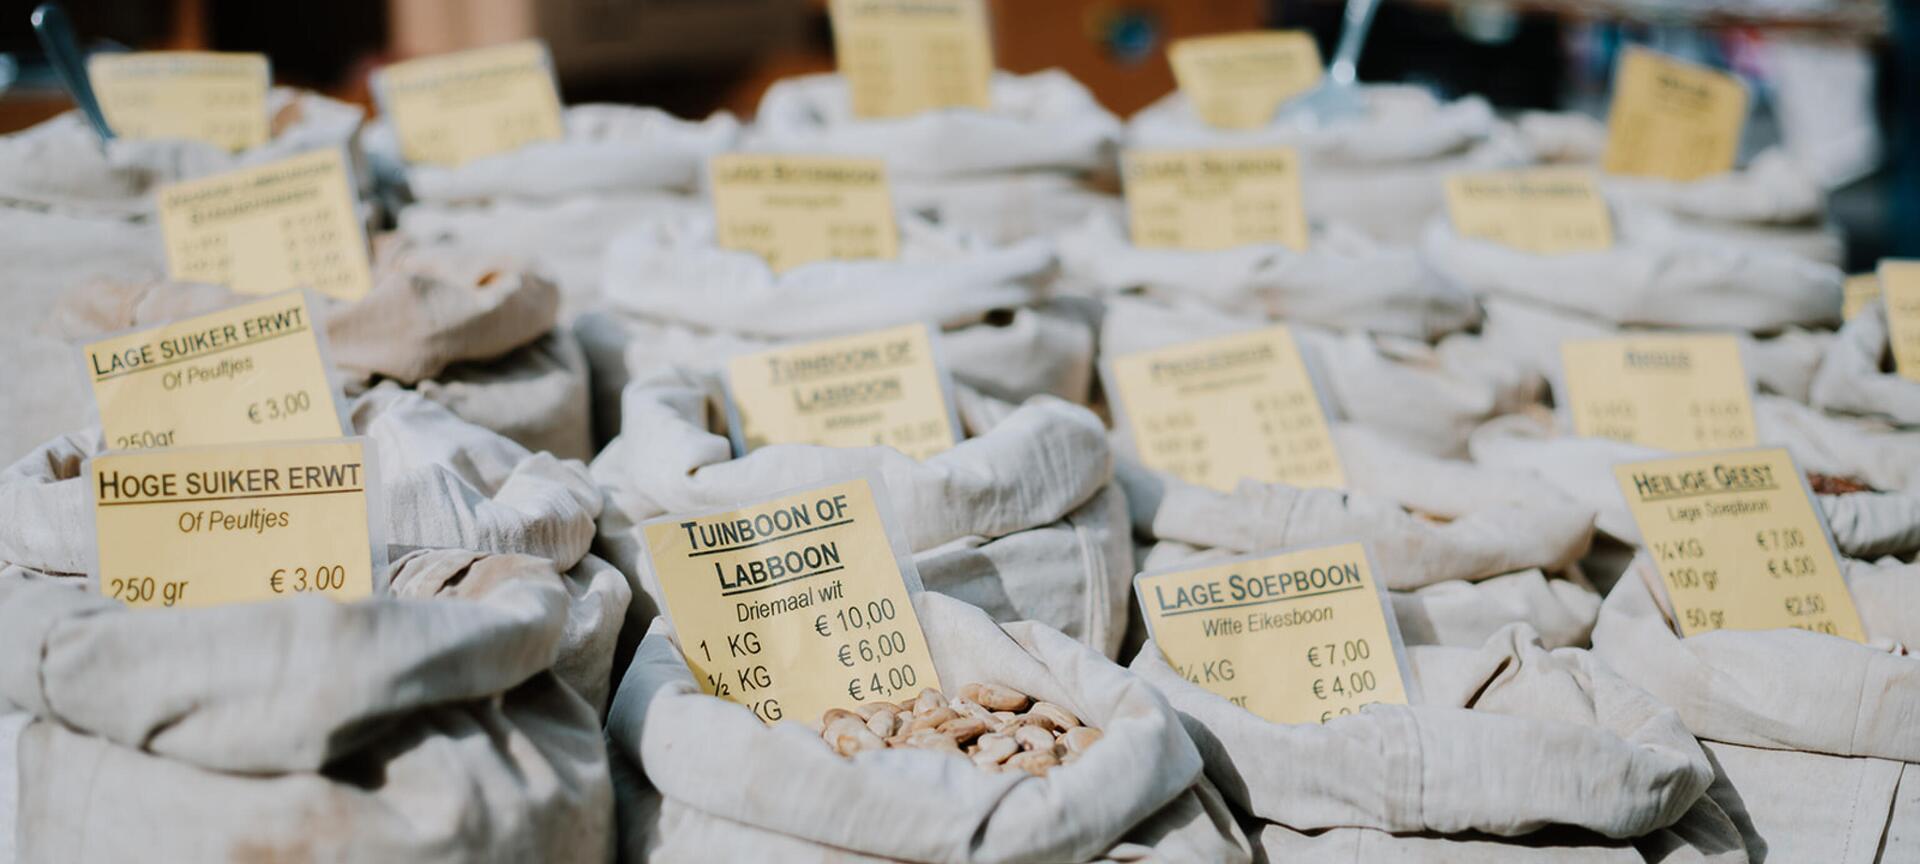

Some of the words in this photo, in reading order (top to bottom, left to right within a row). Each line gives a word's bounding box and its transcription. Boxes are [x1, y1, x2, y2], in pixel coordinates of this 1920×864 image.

[91, 344, 155, 375] LAGE
[160, 324, 238, 359] SUIKER
[244, 306, 303, 339] ERWT
[162, 367, 183, 391] Of
[188, 355, 254, 385] Peultjes
[99, 471, 177, 500] HOGE
[185, 468, 280, 496] SUIKER
[288, 463, 361, 490] ERWT
[1632, 466, 1708, 496] HEILIGE
[1713, 463, 1773, 488] GEEST
[178, 511, 204, 533] Of
[208, 508, 289, 534] Peultjes
[680, 503, 812, 551] TUINBOON
[815, 494, 849, 521] OF
[715, 541, 841, 590] LABBOON
[111, 577, 155, 602] 250
[162, 579, 189, 607] gr
[736, 586, 815, 623] Driemaal
[819, 579, 845, 604] wit
[1155, 582, 1225, 612] LAGE
[1228, 562, 1362, 602] SOEPBOON
[1202, 617, 1243, 638] Witte
[1247, 606, 1334, 633] Eikesboon
[700, 640, 712, 662] 1
[727, 631, 762, 658] KG
[737, 665, 772, 692] KG
[1203, 659, 1235, 684] KG
